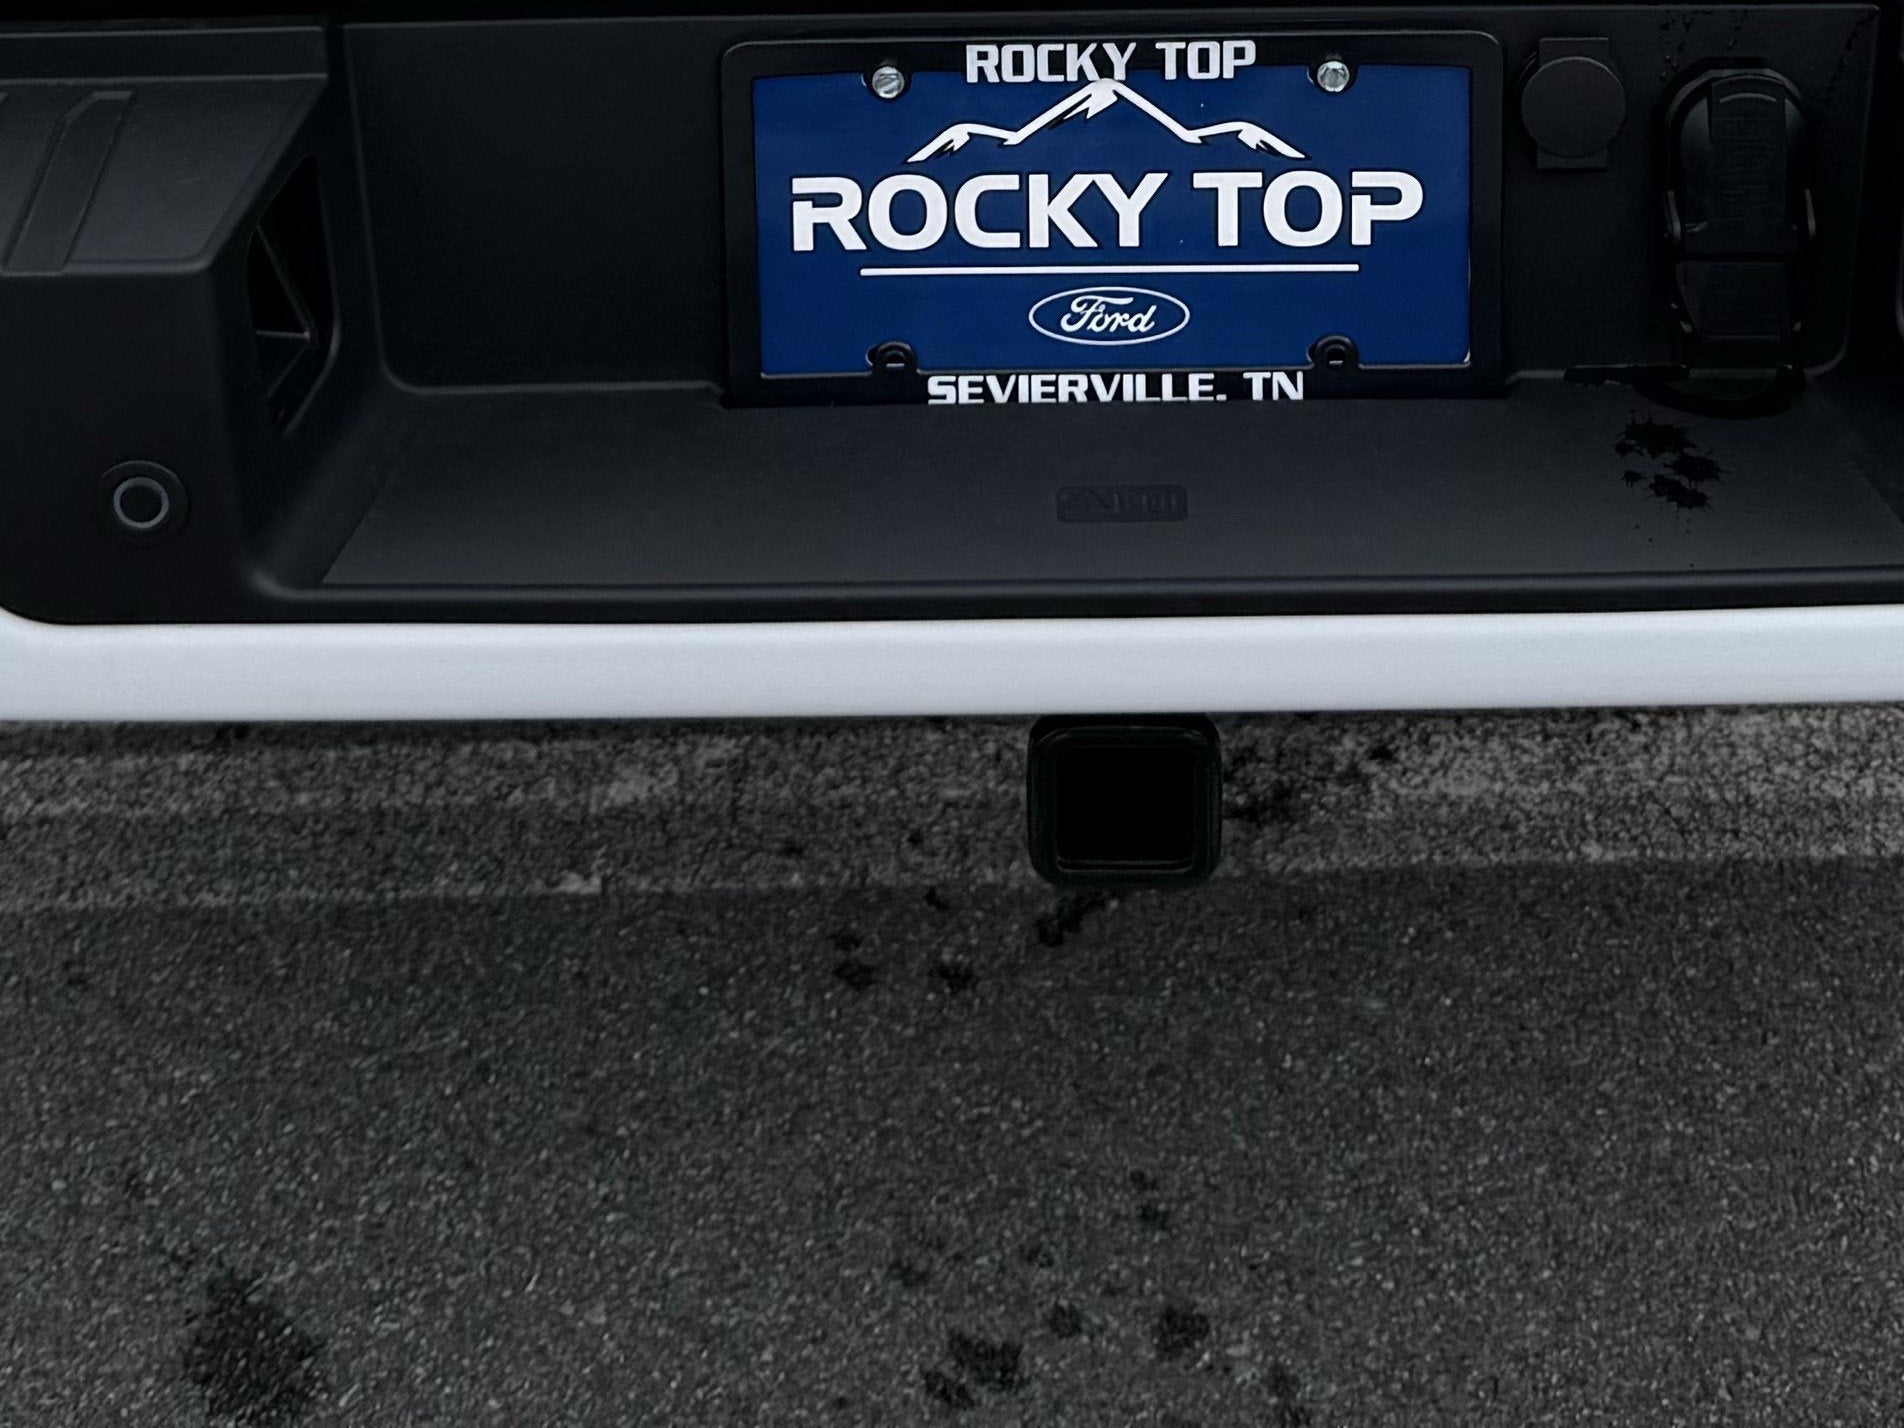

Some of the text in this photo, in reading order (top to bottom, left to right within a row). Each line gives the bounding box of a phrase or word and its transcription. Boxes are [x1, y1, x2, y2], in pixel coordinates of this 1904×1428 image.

[966, 39, 1257, 84] ROCKY TOP
[791, 169, 1425, 252] ROCKY TOP
[1060, 292, 1158, 336] Ford
[1242, 370, 1305, 402] TN
